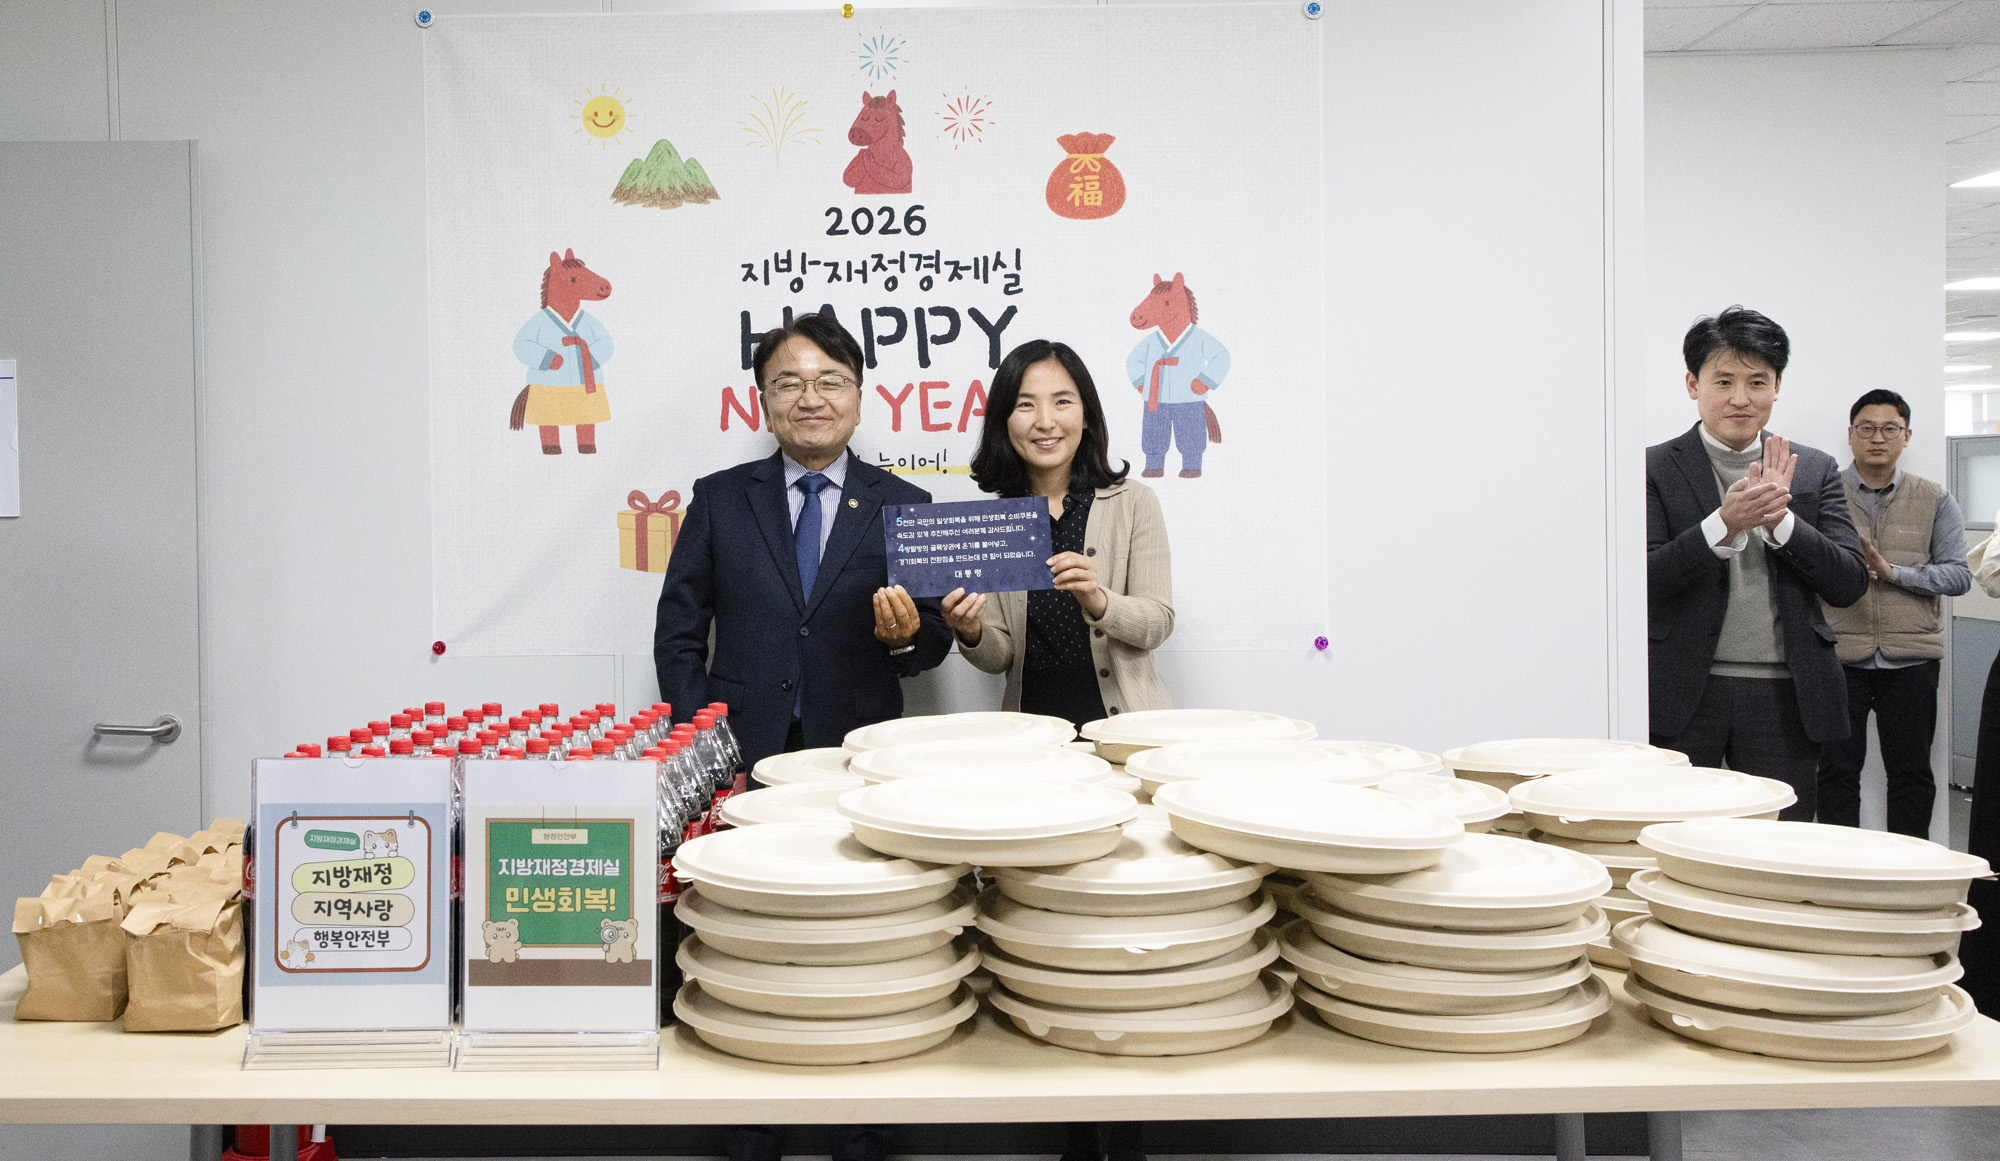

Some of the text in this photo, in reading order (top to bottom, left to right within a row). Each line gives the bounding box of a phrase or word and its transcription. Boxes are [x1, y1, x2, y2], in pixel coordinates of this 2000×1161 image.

[1066, 175, 1103, 207] 福
[825, 204, 927, 236] 2026
[741, 247, 1023, 295] 지방재정경제실
[740, 303, 1018, 370] HPPY
[876, 379, 991, 433] YEA
[896, 511, 1038, 527] 5천만 국민의 일상회복을 위해 민생회복 소비쿠폰을
[930, 529, 961, 537] 추진해주신
[961, 527, 986, 535] 여러분께
[987, 525, 1026, 533] 감사드립니다.
[897, 543, 929, 553] 4방팔방의
[930, 543, 961, 552] 골목상권에
[962, 541, 980, 549] 온기를
[898, 550, 1036, 566] 경기회복의 전환점을 만드는데 큰 힘이 되었습니다.
[309, 834, 357, 846] 지방재정경제실
[312, 863, 393, 889] 지방재정
[498, 858, 621, 877] 지방재정경제실
[313, 899, 394, 922] 지역사랑
[505, 887, 616, 913] 민생회복!
[313, 930, 391, 950] 행복안전부
